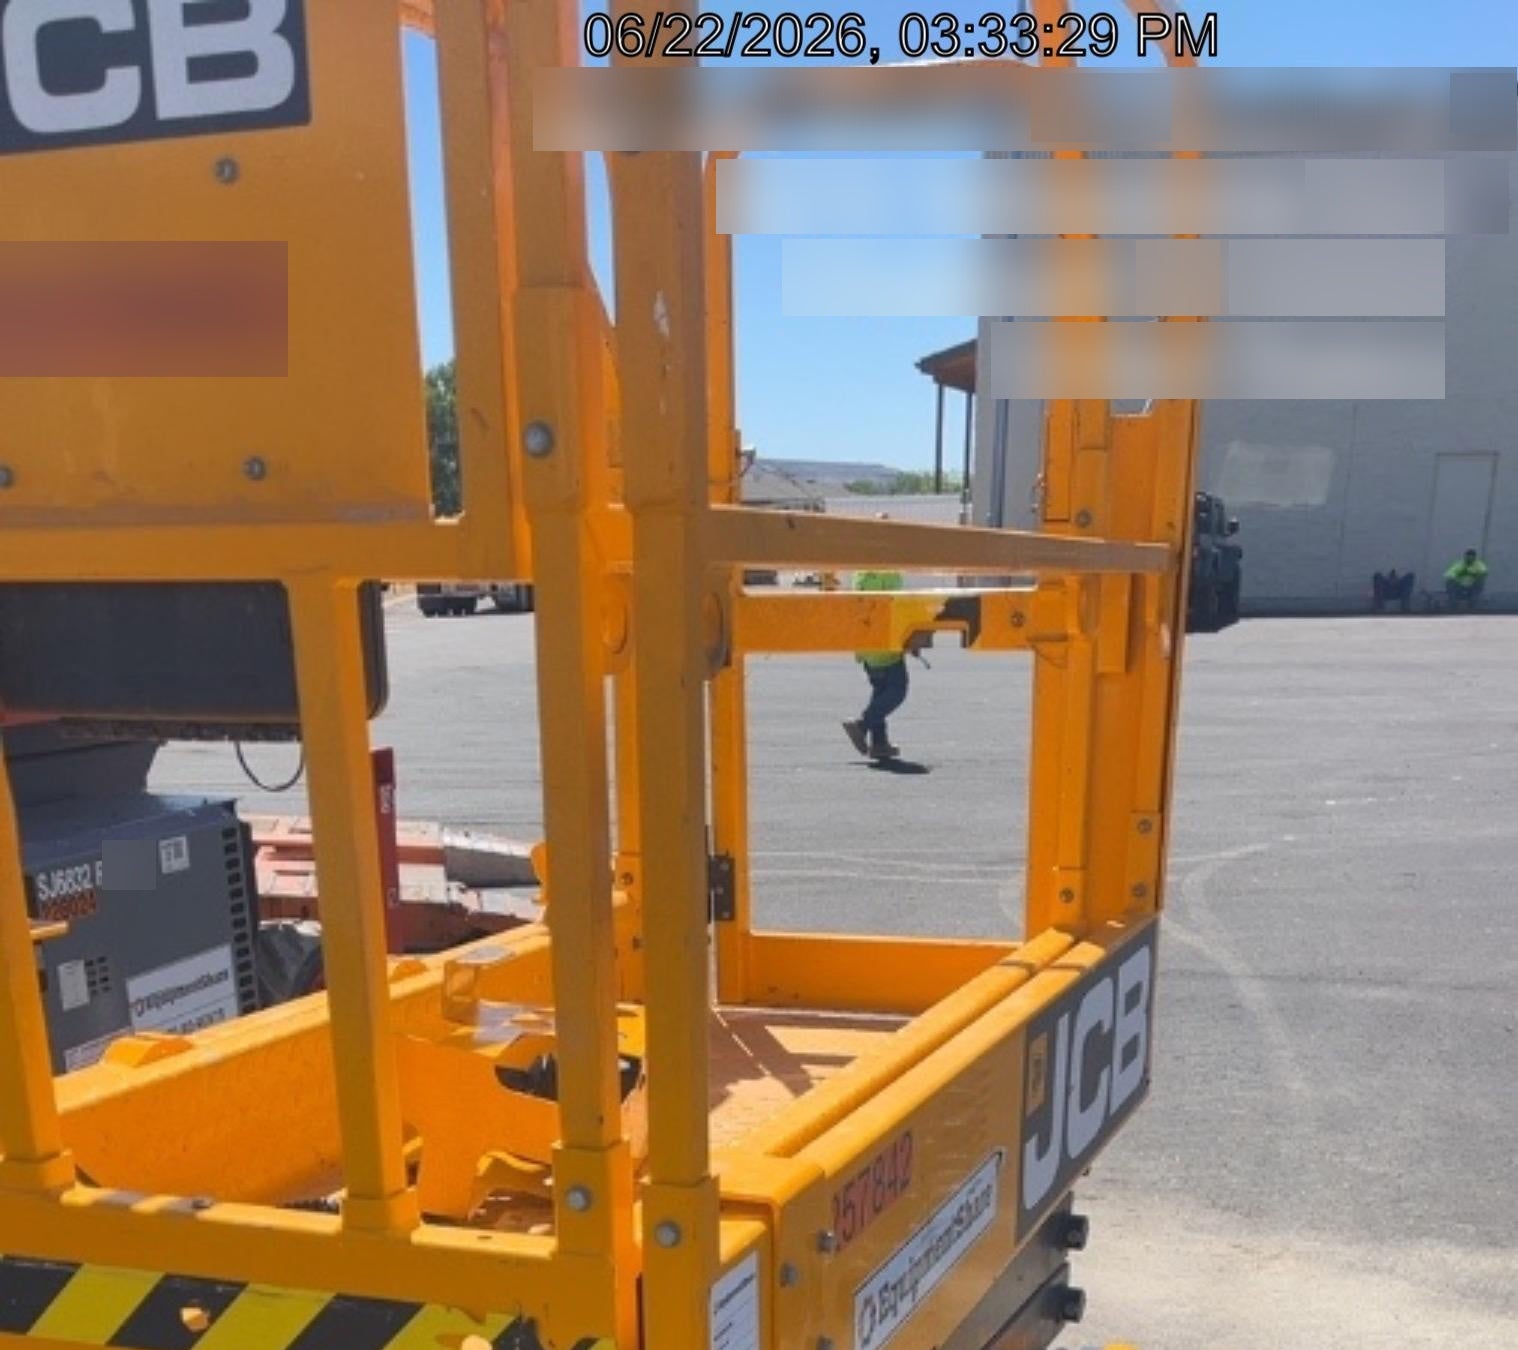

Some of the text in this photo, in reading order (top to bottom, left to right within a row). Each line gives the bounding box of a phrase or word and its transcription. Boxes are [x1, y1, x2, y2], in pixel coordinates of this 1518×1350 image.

[36, 863, 94, 901] SJ6832
[1023, 944, 1150, 1211] JCB
[878, 1182, 993, 1326] EquipmentShare
